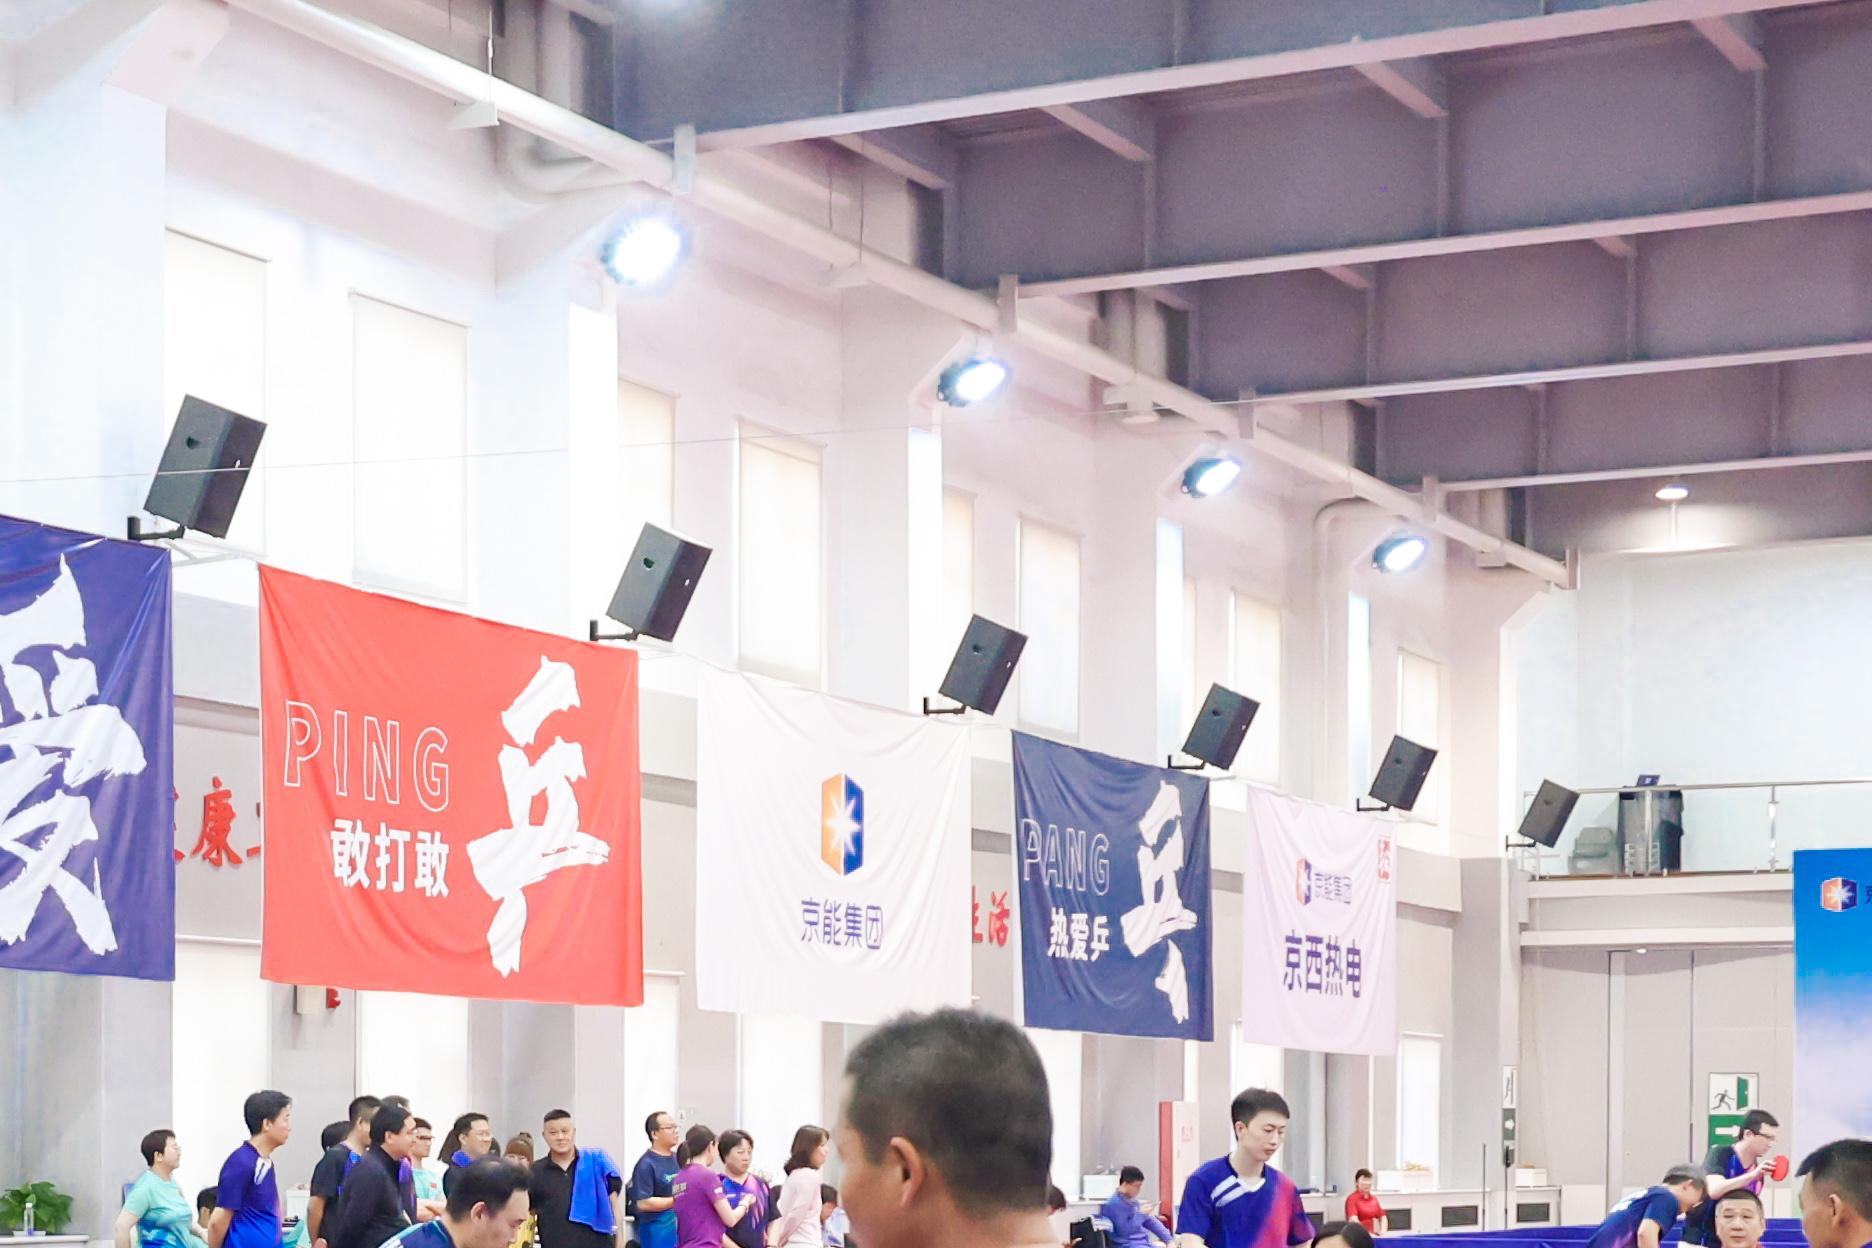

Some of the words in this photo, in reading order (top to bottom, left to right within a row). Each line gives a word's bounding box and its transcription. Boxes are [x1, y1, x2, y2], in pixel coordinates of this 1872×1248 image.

[283, 699, 450, 812] PING
[466, 654, 612, 979] 乒
[330, 818, 451, 898] 敢打敢
[1021, 817, 1110, 896] PANG
[800, 897, 883, 950] 京能集团
[1047, 907, 1111, 962] 热爱乒
[1283, 928, 1362, 998] 京西热电
